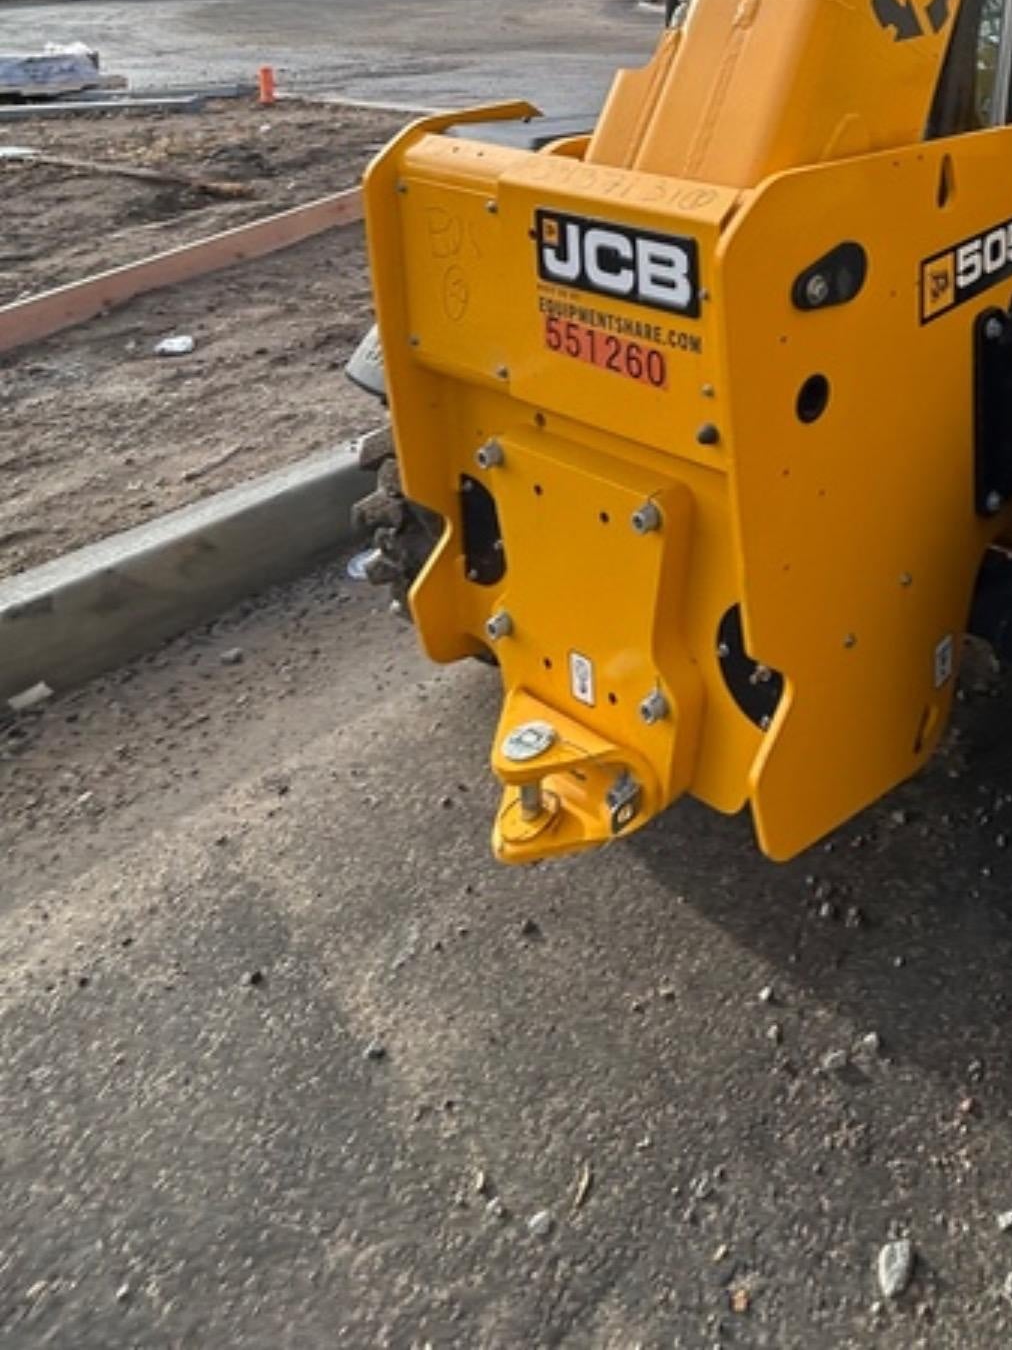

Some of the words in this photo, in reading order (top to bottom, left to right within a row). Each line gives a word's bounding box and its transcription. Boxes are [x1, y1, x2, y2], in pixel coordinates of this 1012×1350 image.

[542, 223, 692, 309] JCB
[539, 296, 702, 354] EQUIPMENTSHARE.COM
[545, 316, 666, 388] 551260
